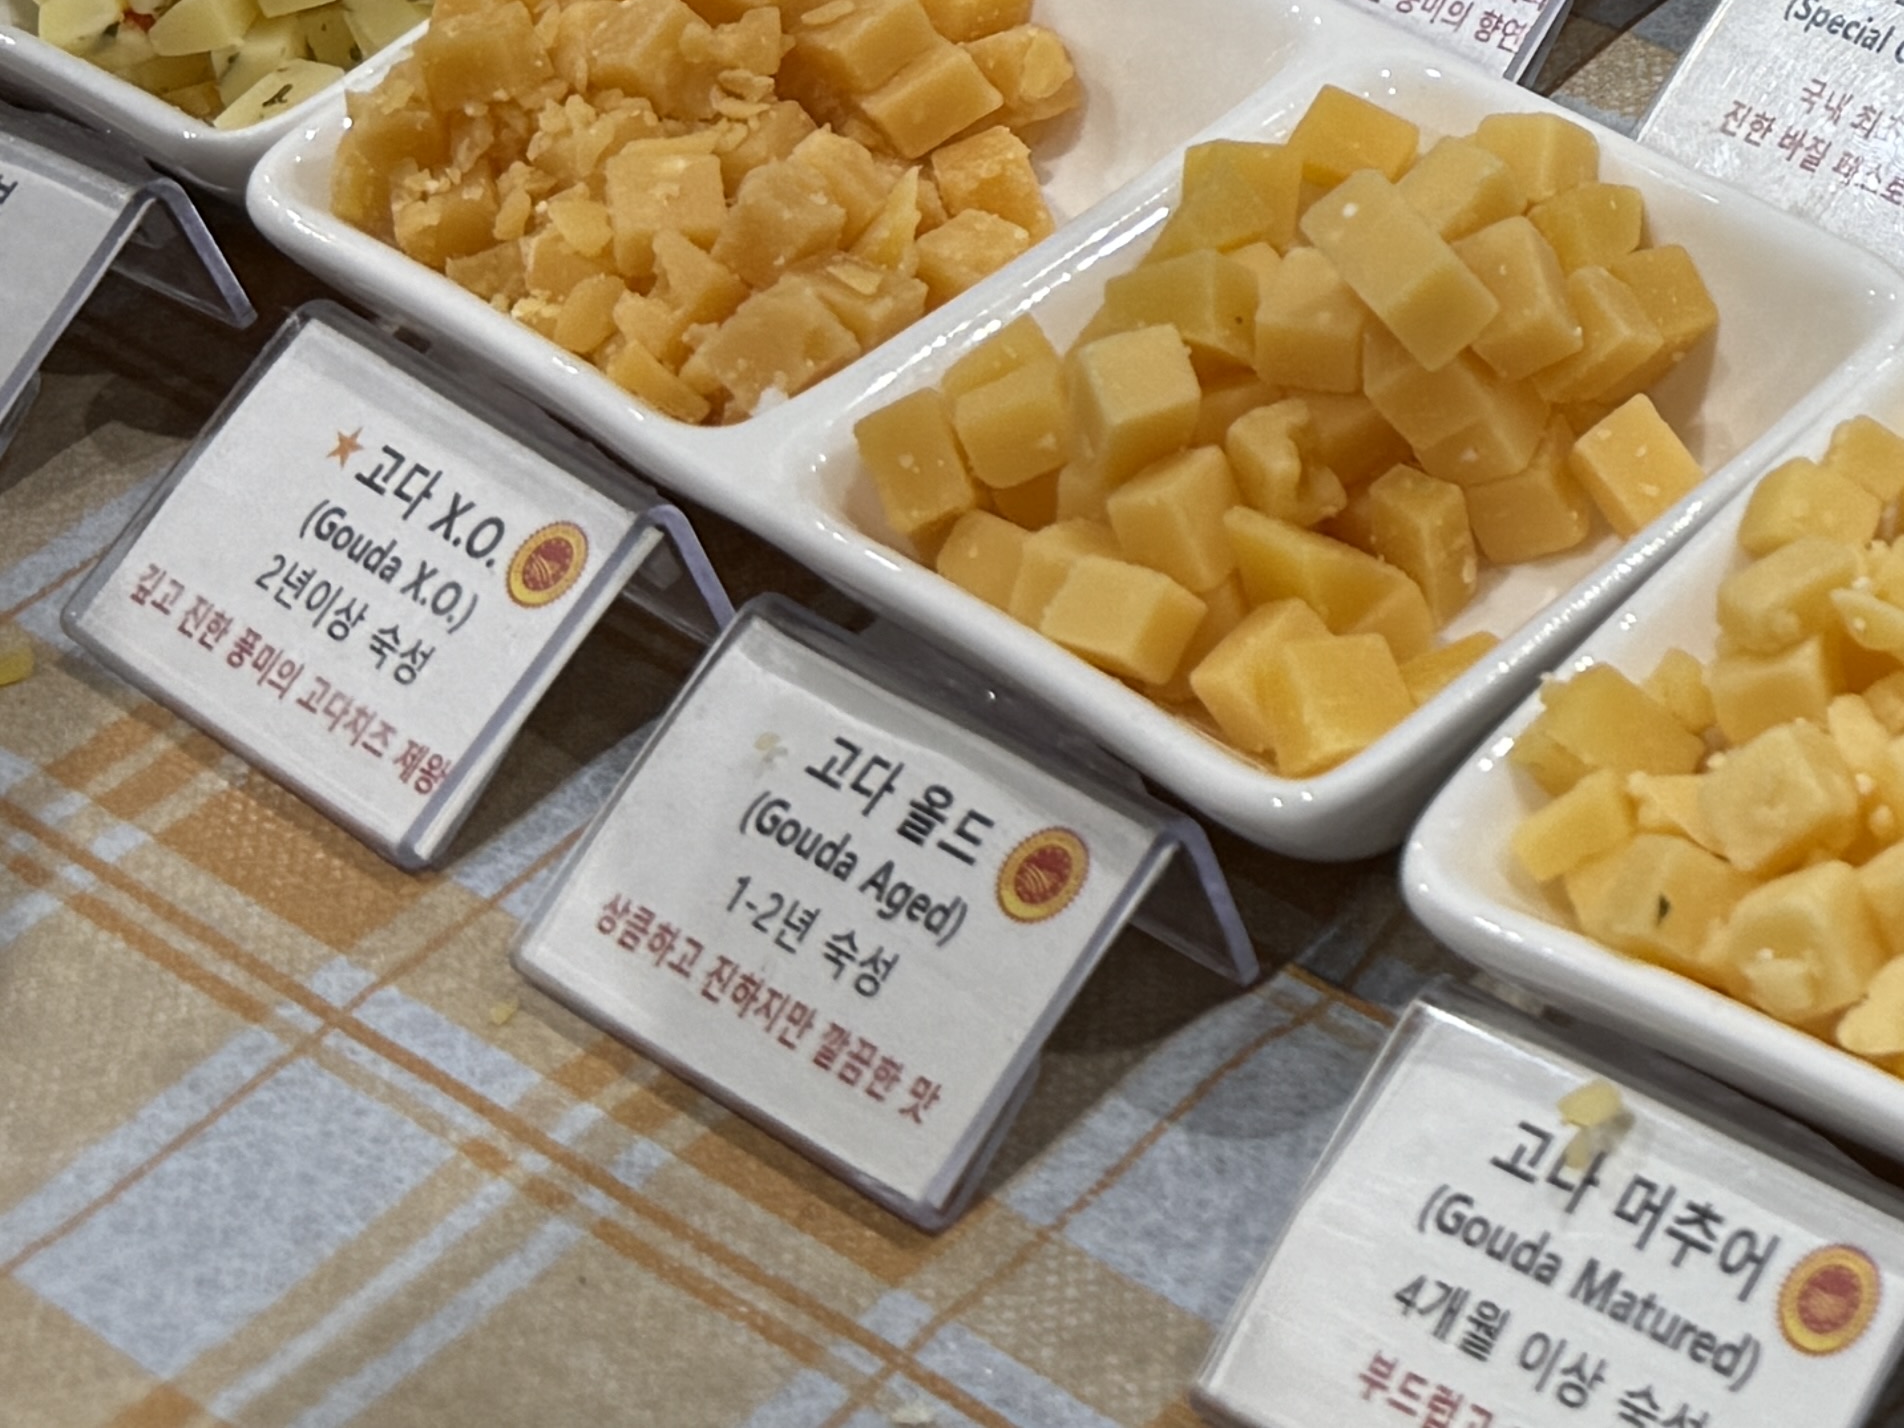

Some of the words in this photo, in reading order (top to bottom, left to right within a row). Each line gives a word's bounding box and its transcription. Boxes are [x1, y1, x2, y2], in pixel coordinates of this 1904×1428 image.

[300, 498, 405, 585] (Gouda
[400, 563, 480, 634] X.O.)
[355, 444, 443, 520] 고다
[430, 492, 505, 569] X.O.
[738, 791, 860, 882] (Gouda
[859, 859, 969, 945] Aged)
[804, 734, 906, 818] 고다
[897, 782, 996, 868] 올드
[1415, 1183, 1564, 1289] (Gouda
[1572, 1258, 1766, 1393] Matured)
[1613, 1166, 1783, 1305] 머추어
[1392, 1275, 1508, 1363] 4개월
[1516, 1332, 1611, 1406] 이상
